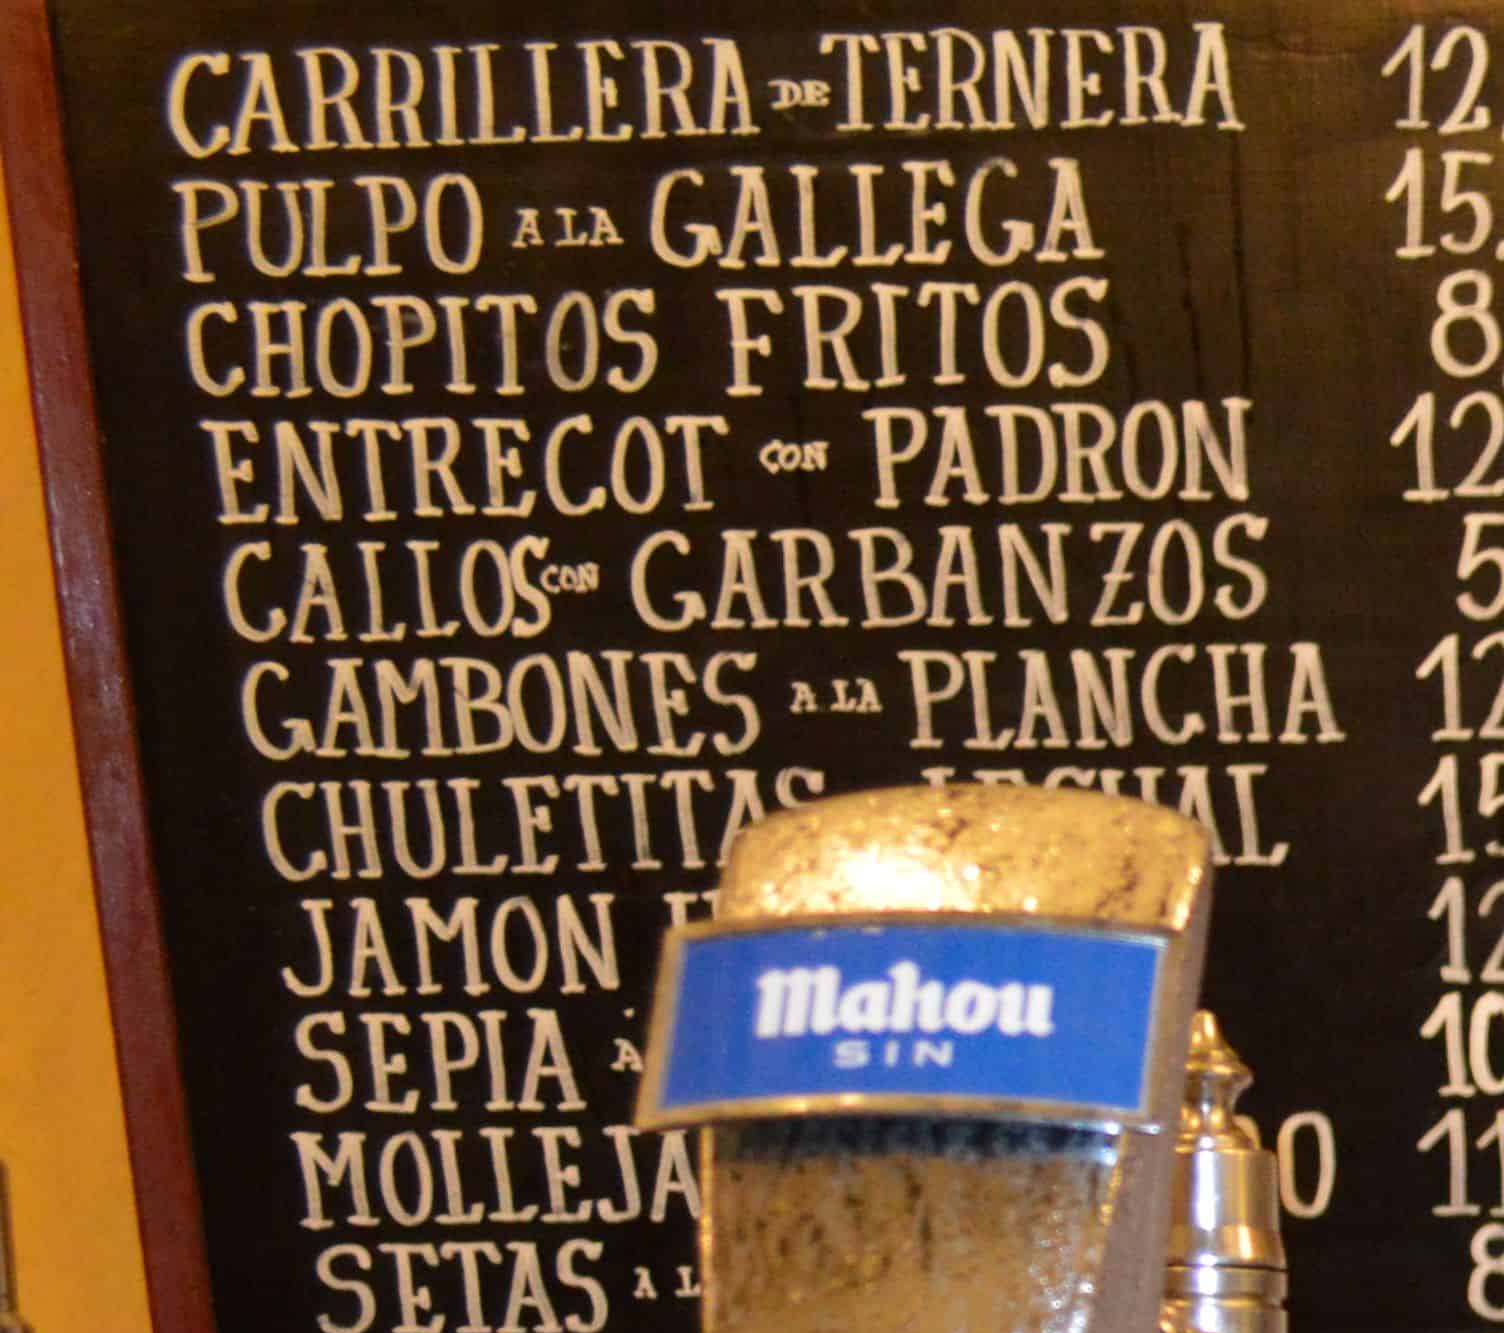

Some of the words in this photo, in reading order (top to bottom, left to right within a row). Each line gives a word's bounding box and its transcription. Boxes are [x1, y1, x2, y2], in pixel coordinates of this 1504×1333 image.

[167, 39, 761, 158] CARRILLERA
[821, 21, 1246, 133] TERNERA
[171, 172, 484, 283] PULPO
[649, 158, 1105, 269] GALLEGA
[186, 288, 659, 397] CHOPITOS
[716, 278, 1110, 397] FRITOS
[200, 413, 729, 525] ENTRECOT
[863, 398, 1252, 508] PADRON
[224, 536, 549, 643] CALLOS
[630, 514, 1269, 631] GARBANZOS
[240, 651, 762, 760] GAMBONES
[900, 642, 1346, 750] PLANCHA
[283, 893, 620, 997] JAMON
[755, 959, 1055, 1039] Mahou
[295, 1009, 587, 1114] SEPIA
[833, 1041, 954, 1069] SIN
[291, 1124, 701, 1231] MOLLEJA
